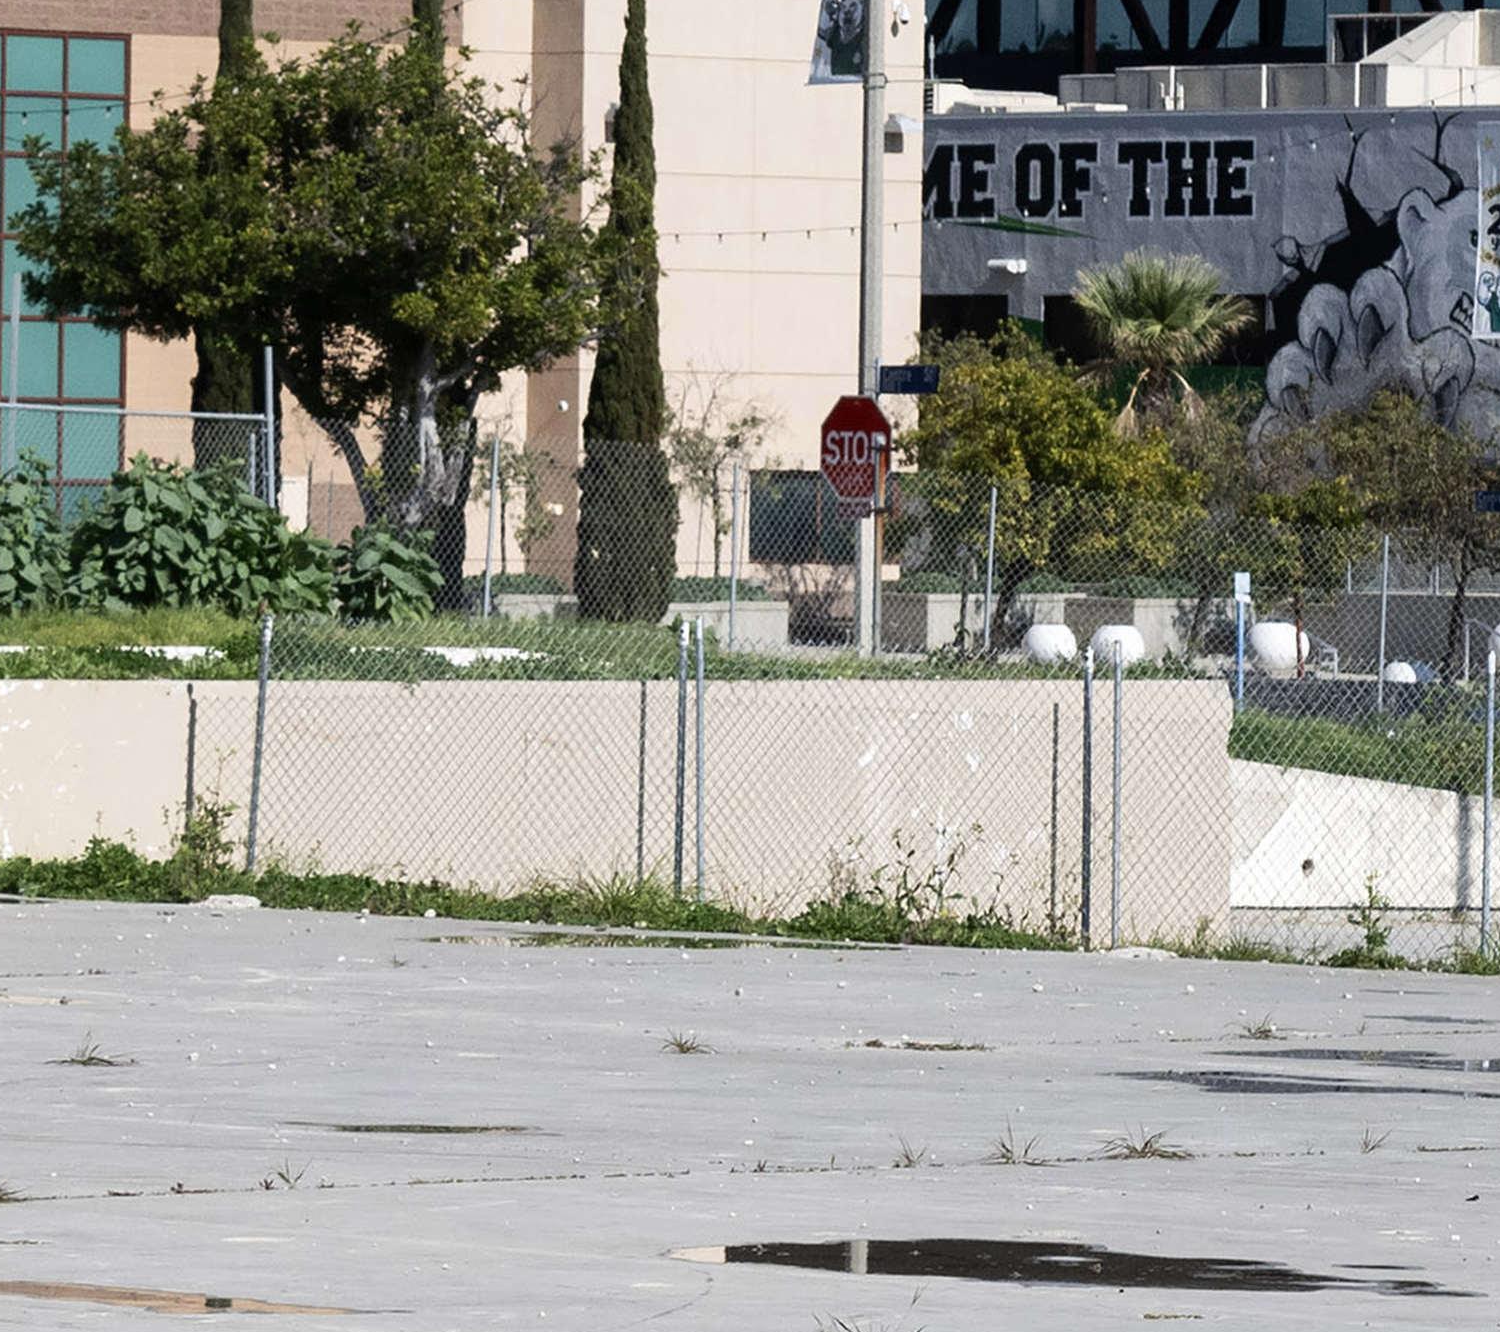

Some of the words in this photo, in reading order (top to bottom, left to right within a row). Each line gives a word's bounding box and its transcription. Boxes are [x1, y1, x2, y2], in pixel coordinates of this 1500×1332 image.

[1013, 139, 1099, 220] OF
[1117, 137, 1255, 219] THE
[826, 430, 887, 465] STOP
